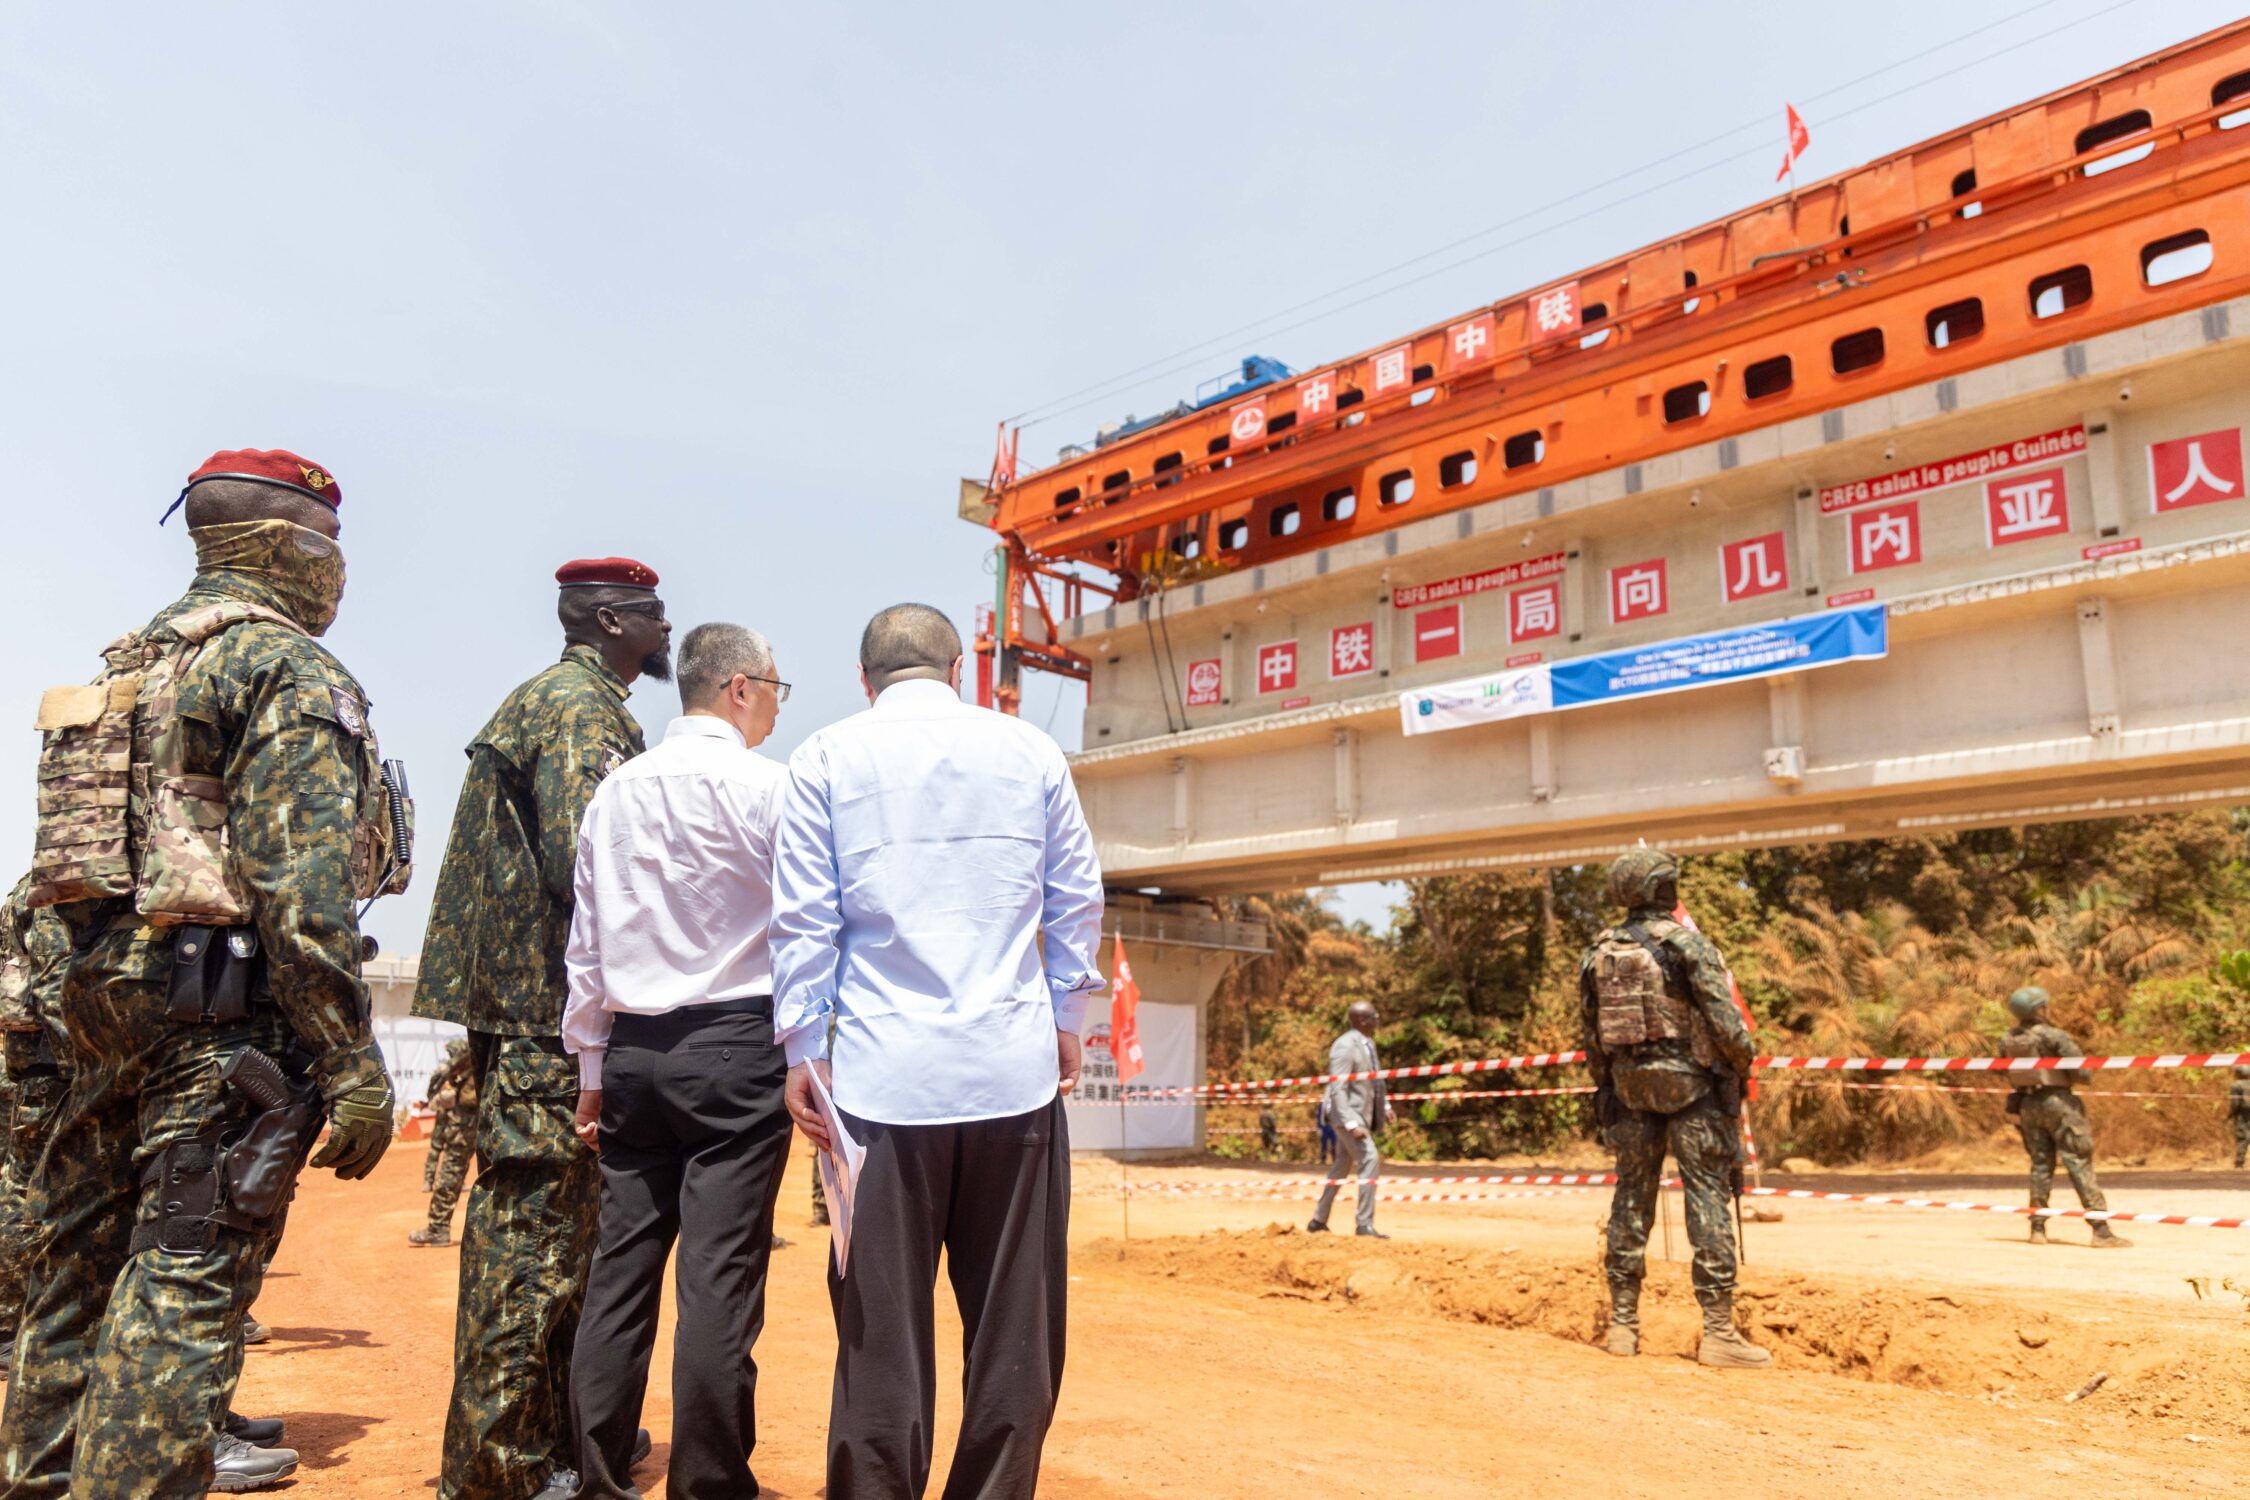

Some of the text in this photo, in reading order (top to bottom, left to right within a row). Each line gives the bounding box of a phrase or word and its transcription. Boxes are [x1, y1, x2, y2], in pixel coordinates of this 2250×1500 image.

[1303, 291, 1574, 413] 中国中铁
[1822, 430, 2086, 508] CRFG salut le peuple Guinée
[1396, 587, 1427, 604] CRFG
[1429, 580, 1460, 599] salut
[1461, 578, 1474, 592] le
[1475, 567, 1519, 591] peuple
